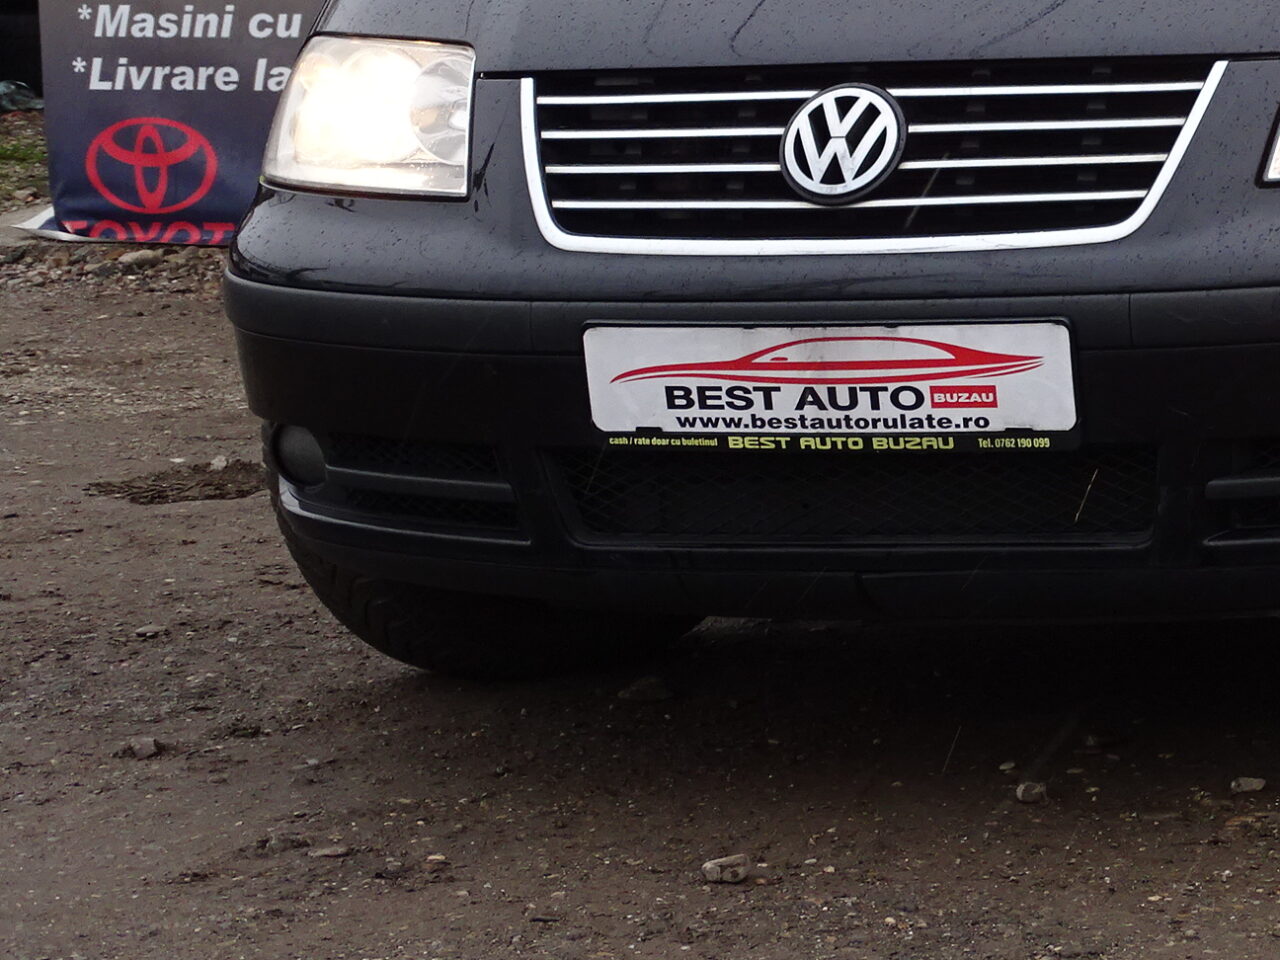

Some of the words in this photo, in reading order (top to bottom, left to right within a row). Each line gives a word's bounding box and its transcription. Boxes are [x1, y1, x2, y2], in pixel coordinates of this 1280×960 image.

[248, 12, 302, 38] cu
[664, 385, 782, 411] BEST
[793, 385, 925, 411] AUTO
[933, 391, 995, 404] BUZAU
[675, 412, 991, 431] www.bestautorulate.ro
[609, 437, 628, 445] cash
[651, 437, 670, 446] doar
[671, 438, 681, 446] cu
[727, 435, 791, 449] BEST
[800, 436, 864, 450] AUTO
[872, 436, 955, 450] BUZAU
[978, 437, 993, 448] Tel.
[995, 438, 1016, 448] 0762
[1017, 438, 1032, 448] 190
[1033, 438, 1050, 449] 099
